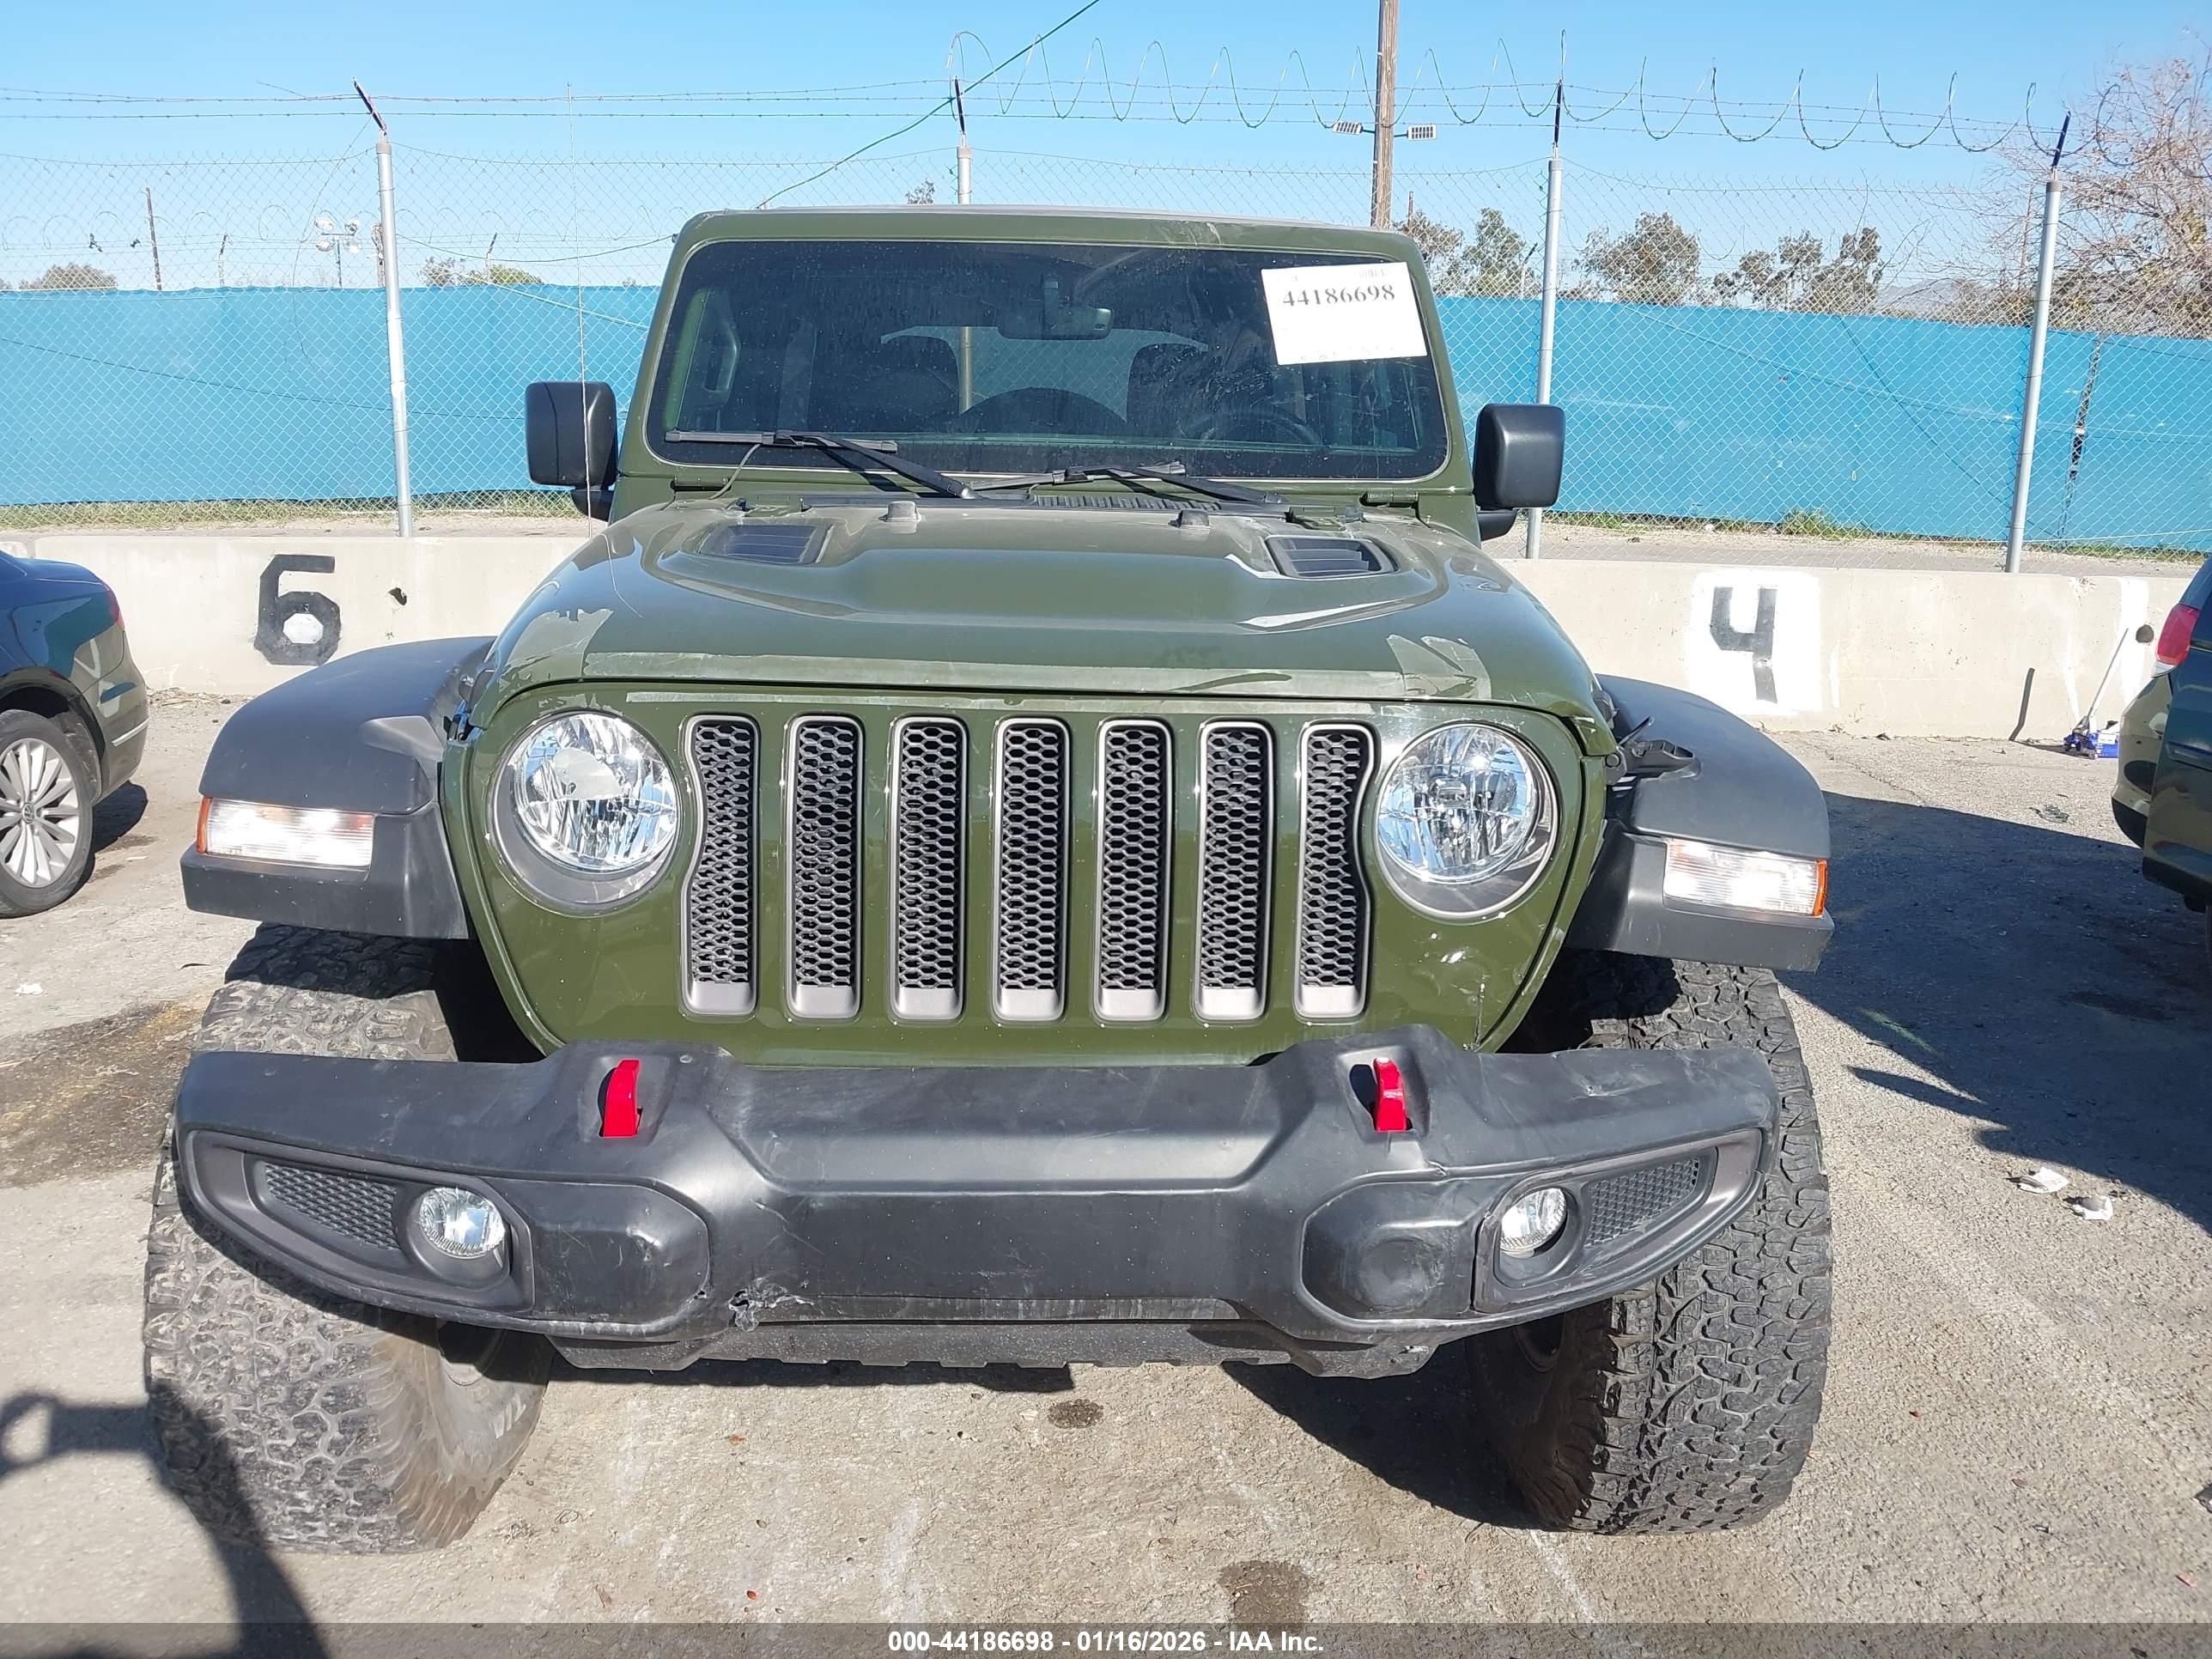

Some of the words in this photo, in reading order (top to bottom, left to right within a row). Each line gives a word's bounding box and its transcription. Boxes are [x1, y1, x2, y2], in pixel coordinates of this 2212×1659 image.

[1282, 284, 1396, 307] 44186698
[254, 555, 342, 665] 6
[1710, 586, 1778, 703] 4
